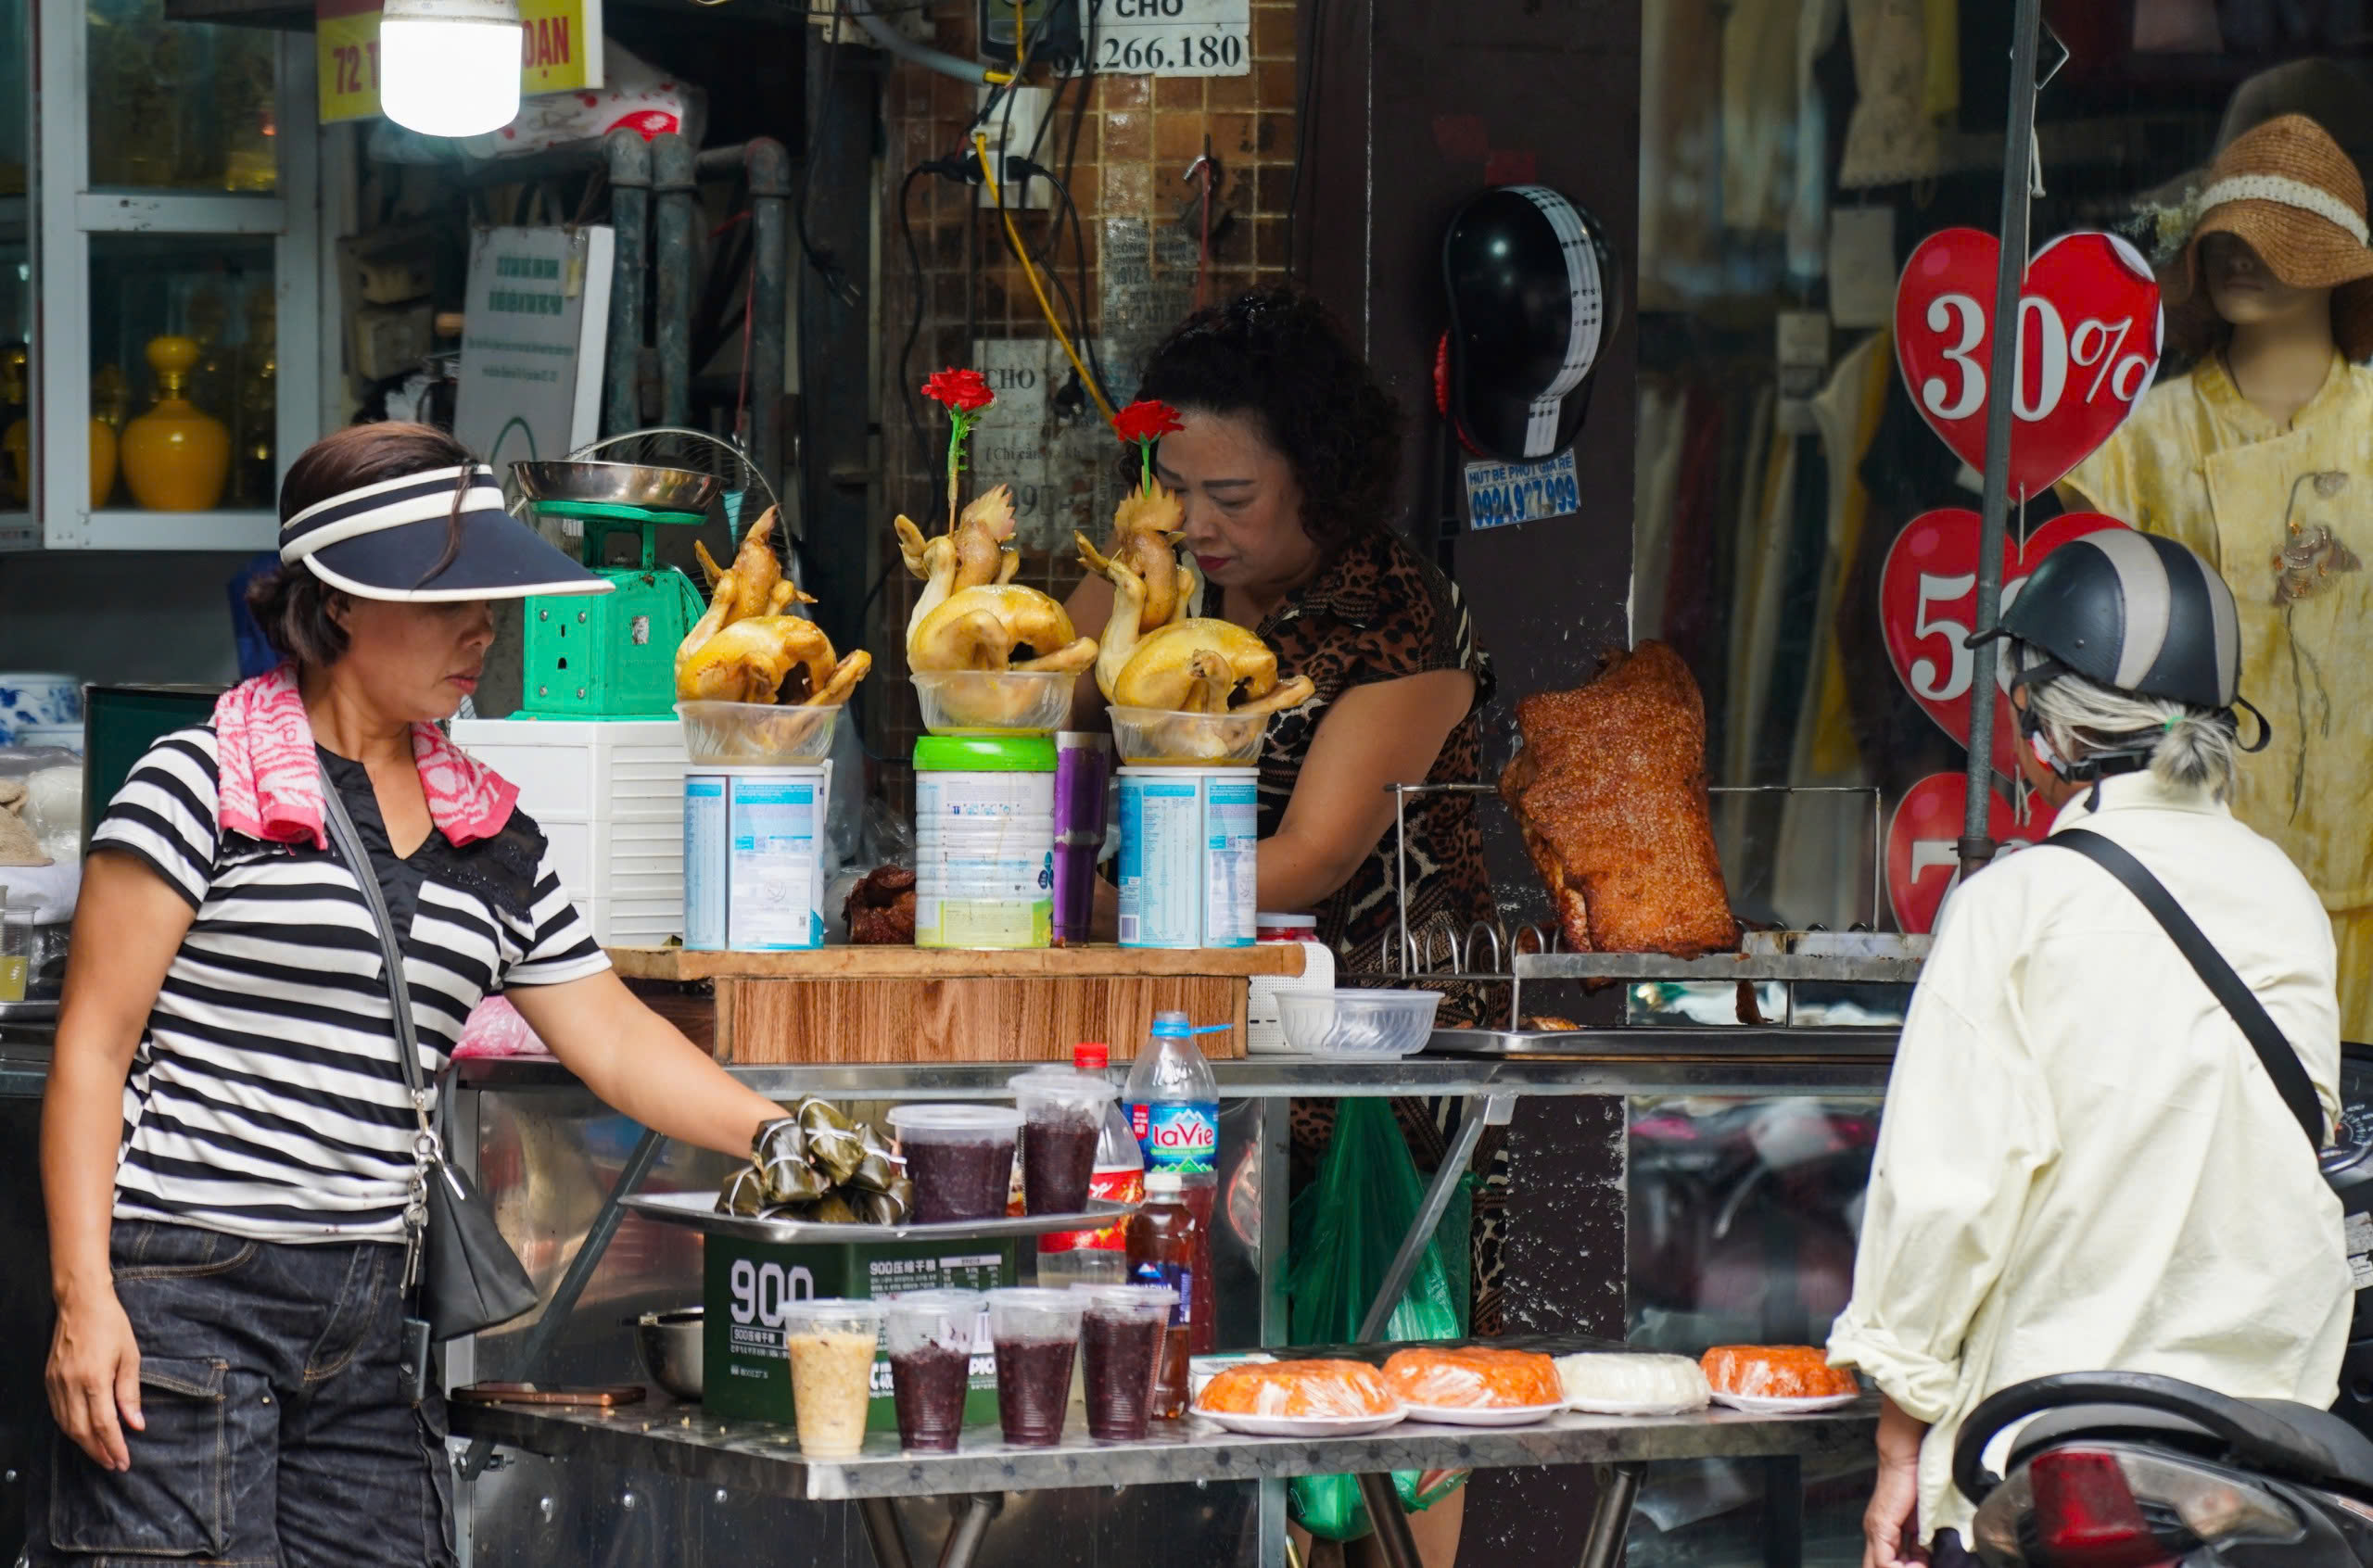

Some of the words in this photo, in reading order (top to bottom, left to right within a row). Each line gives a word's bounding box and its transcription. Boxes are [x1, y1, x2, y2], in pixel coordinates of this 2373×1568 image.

[333, 45, 363, 95] 72
[522, 16, 570, 79] OẠN
[1923, 294, 2150, 422] 30%
[1152, 1121, 1215, 1147] laVie
[730, 1258, 814, 1328] 900
